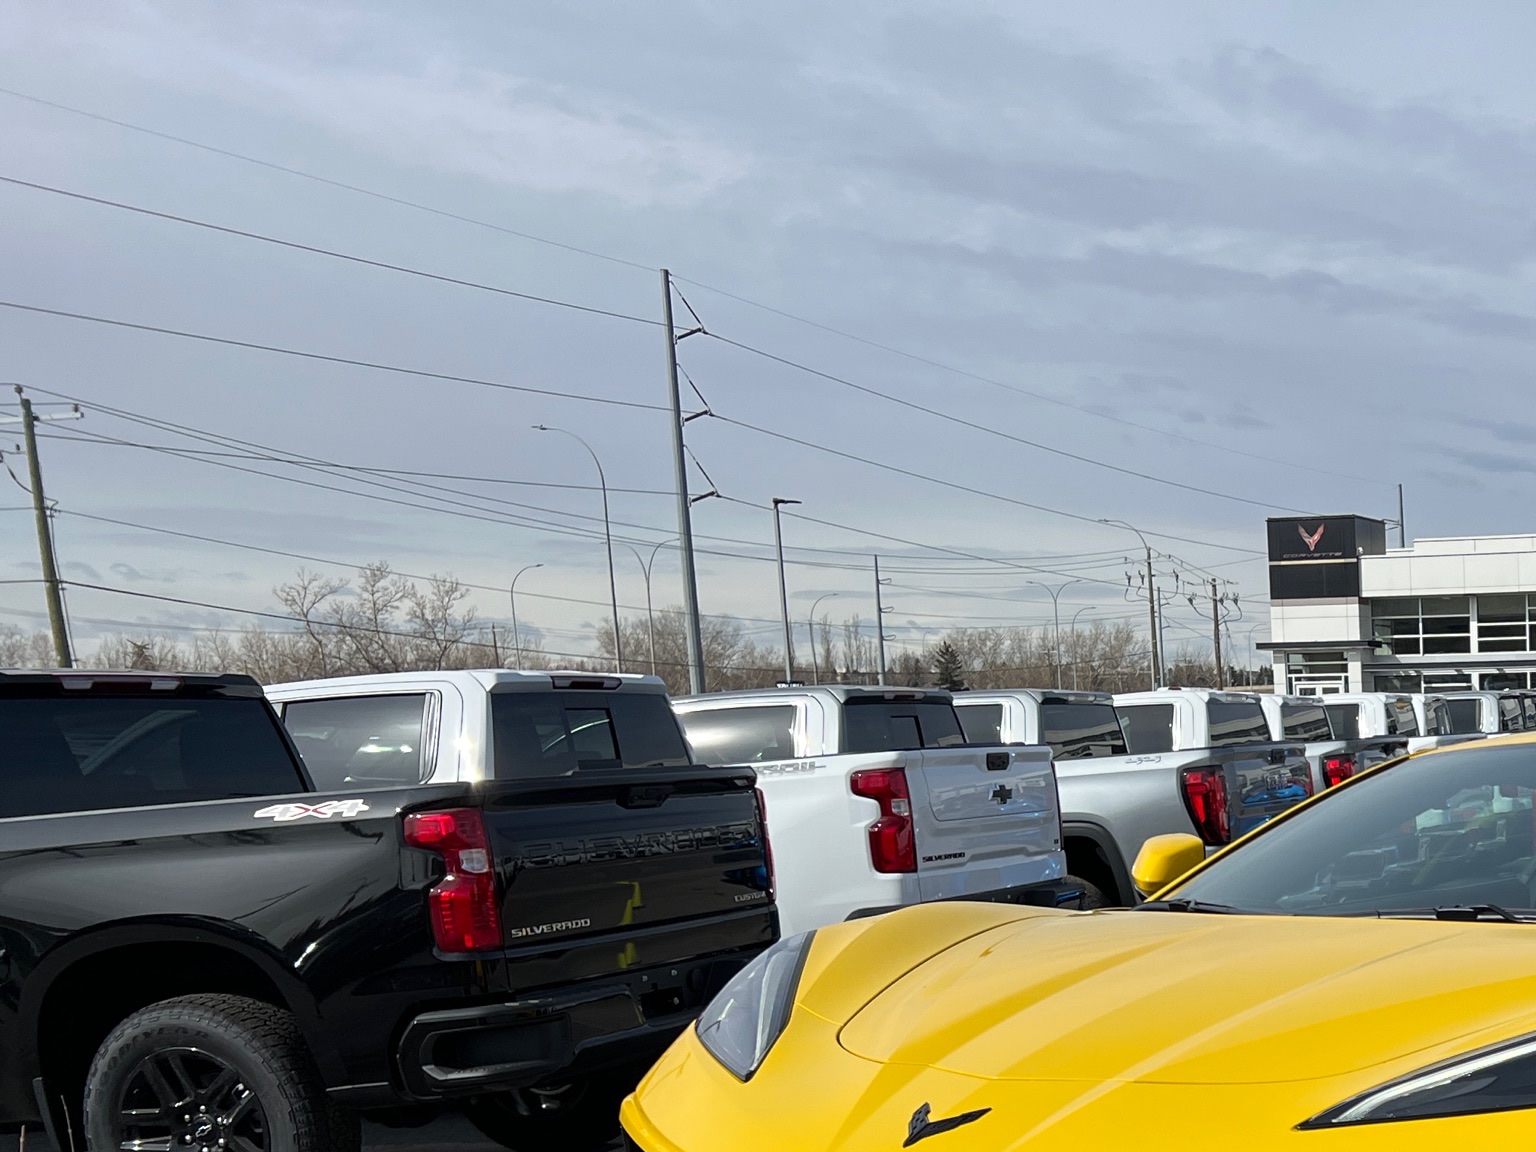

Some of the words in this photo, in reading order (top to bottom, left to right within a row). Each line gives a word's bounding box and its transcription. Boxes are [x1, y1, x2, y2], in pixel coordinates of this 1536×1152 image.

[1283, 551, 1343, 559] CORVETTE
[522, 820, 755, 868] CHEVROLET
[511, 918, 591, 938] SILVERADO
